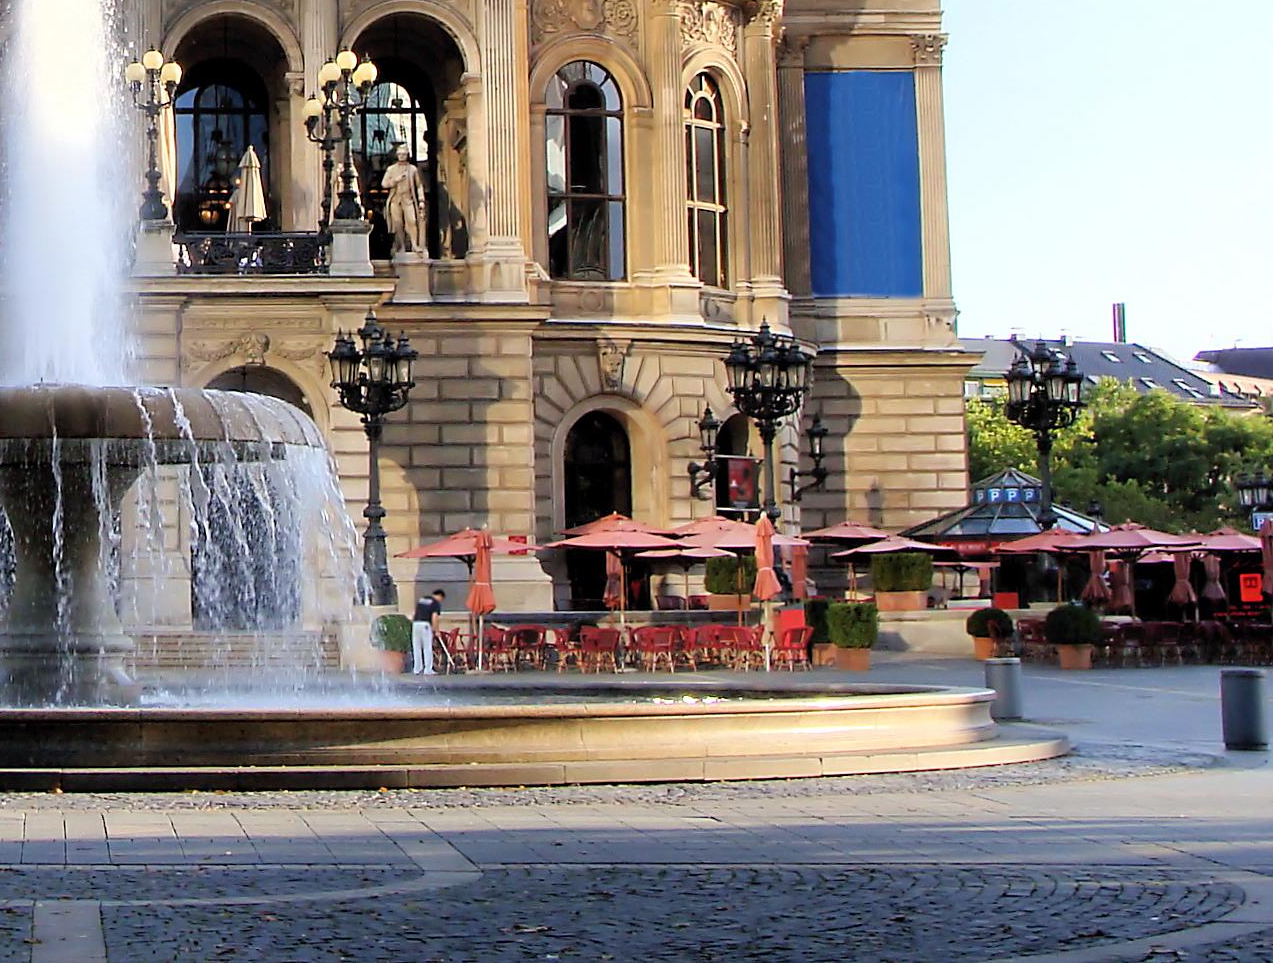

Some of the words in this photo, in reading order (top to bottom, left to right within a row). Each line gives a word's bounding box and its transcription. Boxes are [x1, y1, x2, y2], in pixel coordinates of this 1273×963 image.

[991, 491, 999, 502] P
[1008, 491, 1017, 502] P
[1025, 491, 1033, 501] P
